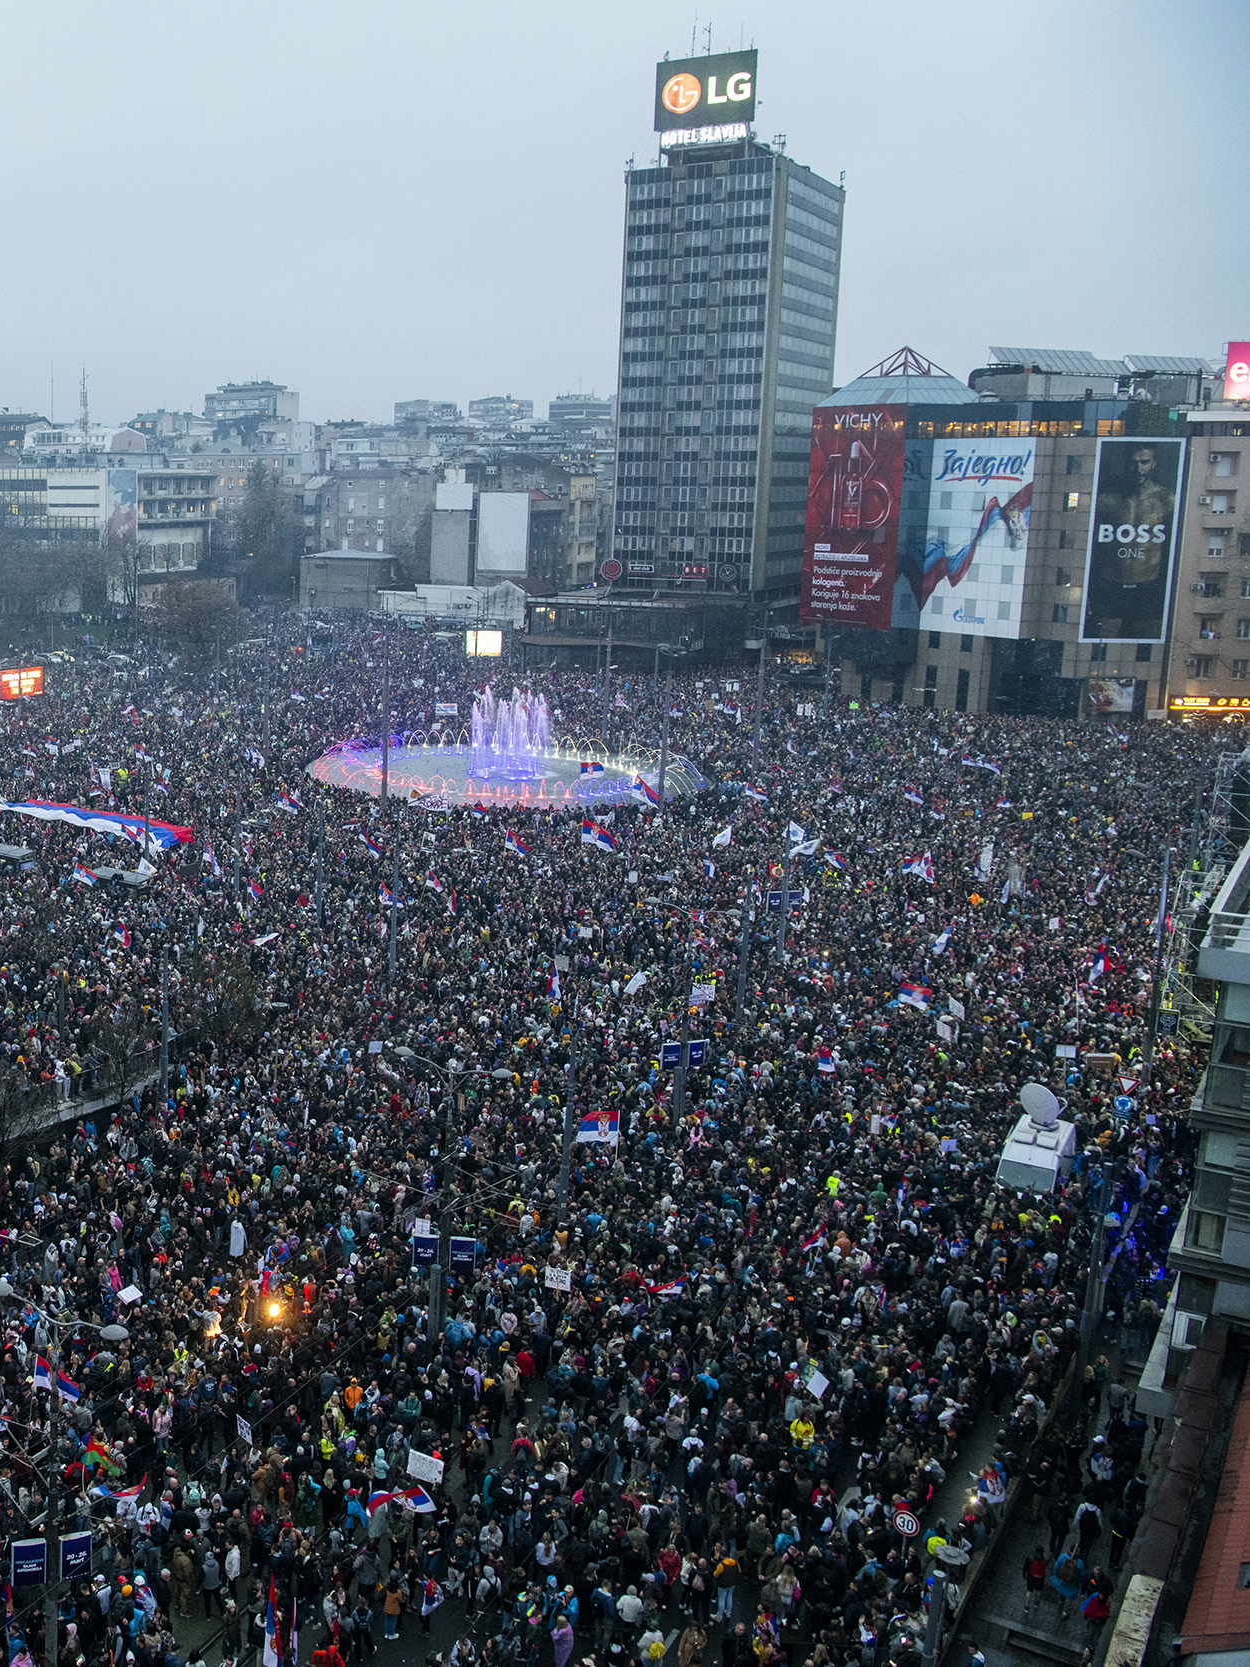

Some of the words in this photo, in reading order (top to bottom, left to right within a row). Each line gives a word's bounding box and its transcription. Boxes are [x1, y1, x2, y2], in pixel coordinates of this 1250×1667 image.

[708, 72, 752, 104] LG
[661, 129, 698, 147] HOTEL
[700, 123, 747, 142] SLAVIJA
[1230, 362, 1250, 382] e
[835, 413, 883, 428] VICHY
[1098, 524, 1166, 544] BOSS
[1118, 548, 1145, 558] ONE
[814, 566, 840, 575] Podstiče
[812, 588, 839, 599] Koriguje
[842, 590, 849, 599] 16
[851, 592, 880, 601] znakova
[811, 601, 837, 611] starenja
[898, 1516, 914, 1531] 30
